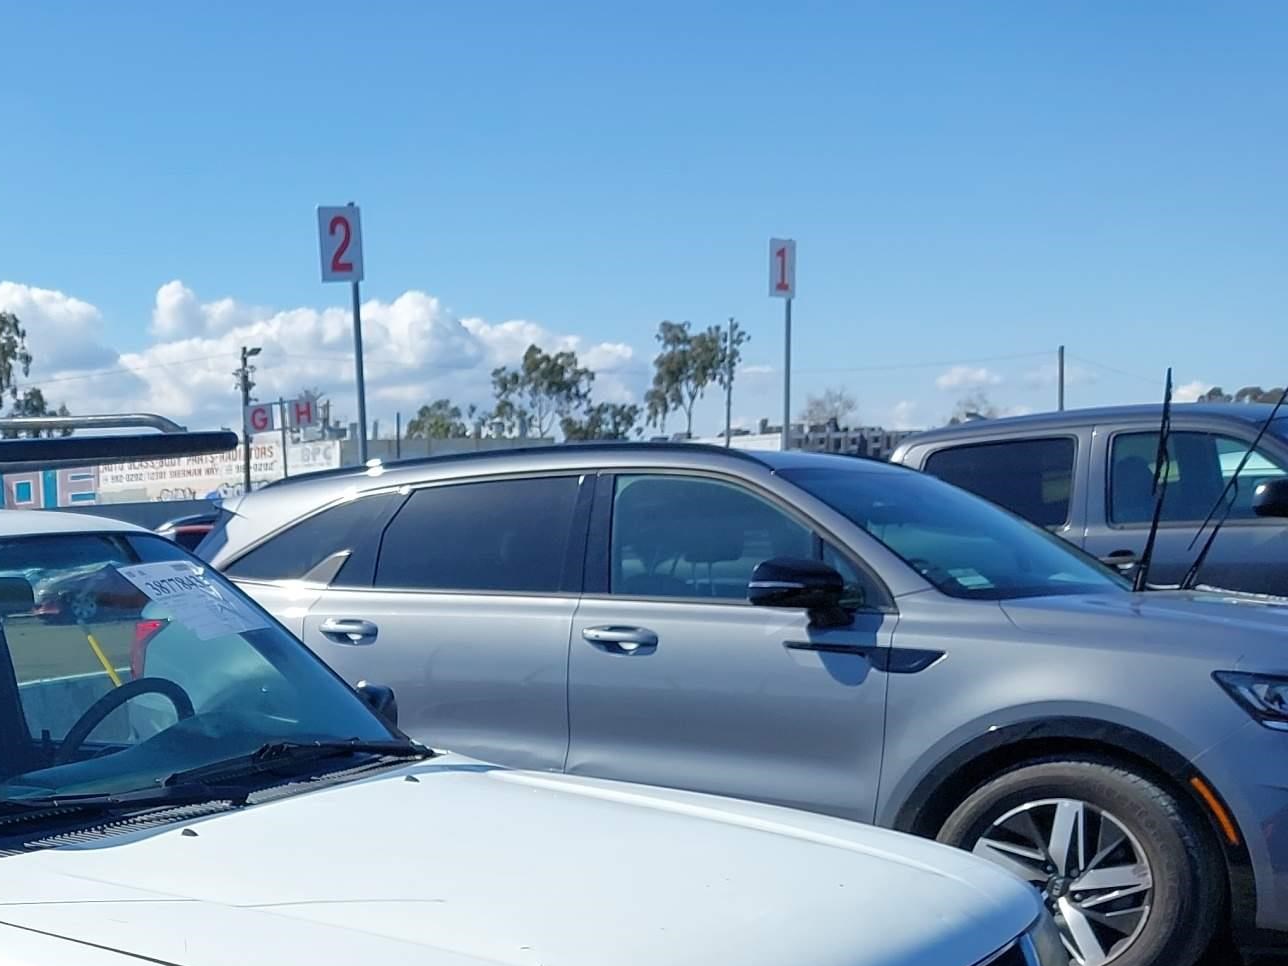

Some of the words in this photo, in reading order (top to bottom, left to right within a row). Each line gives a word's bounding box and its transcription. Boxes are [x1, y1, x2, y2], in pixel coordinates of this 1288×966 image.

[329, 215, 353, 272] 2
[775, 246, 789, 291] 1
[251, 407, 268, 430] G
[295, 401, 312, 424] H
[145, 574, 210, 597] 3877843
